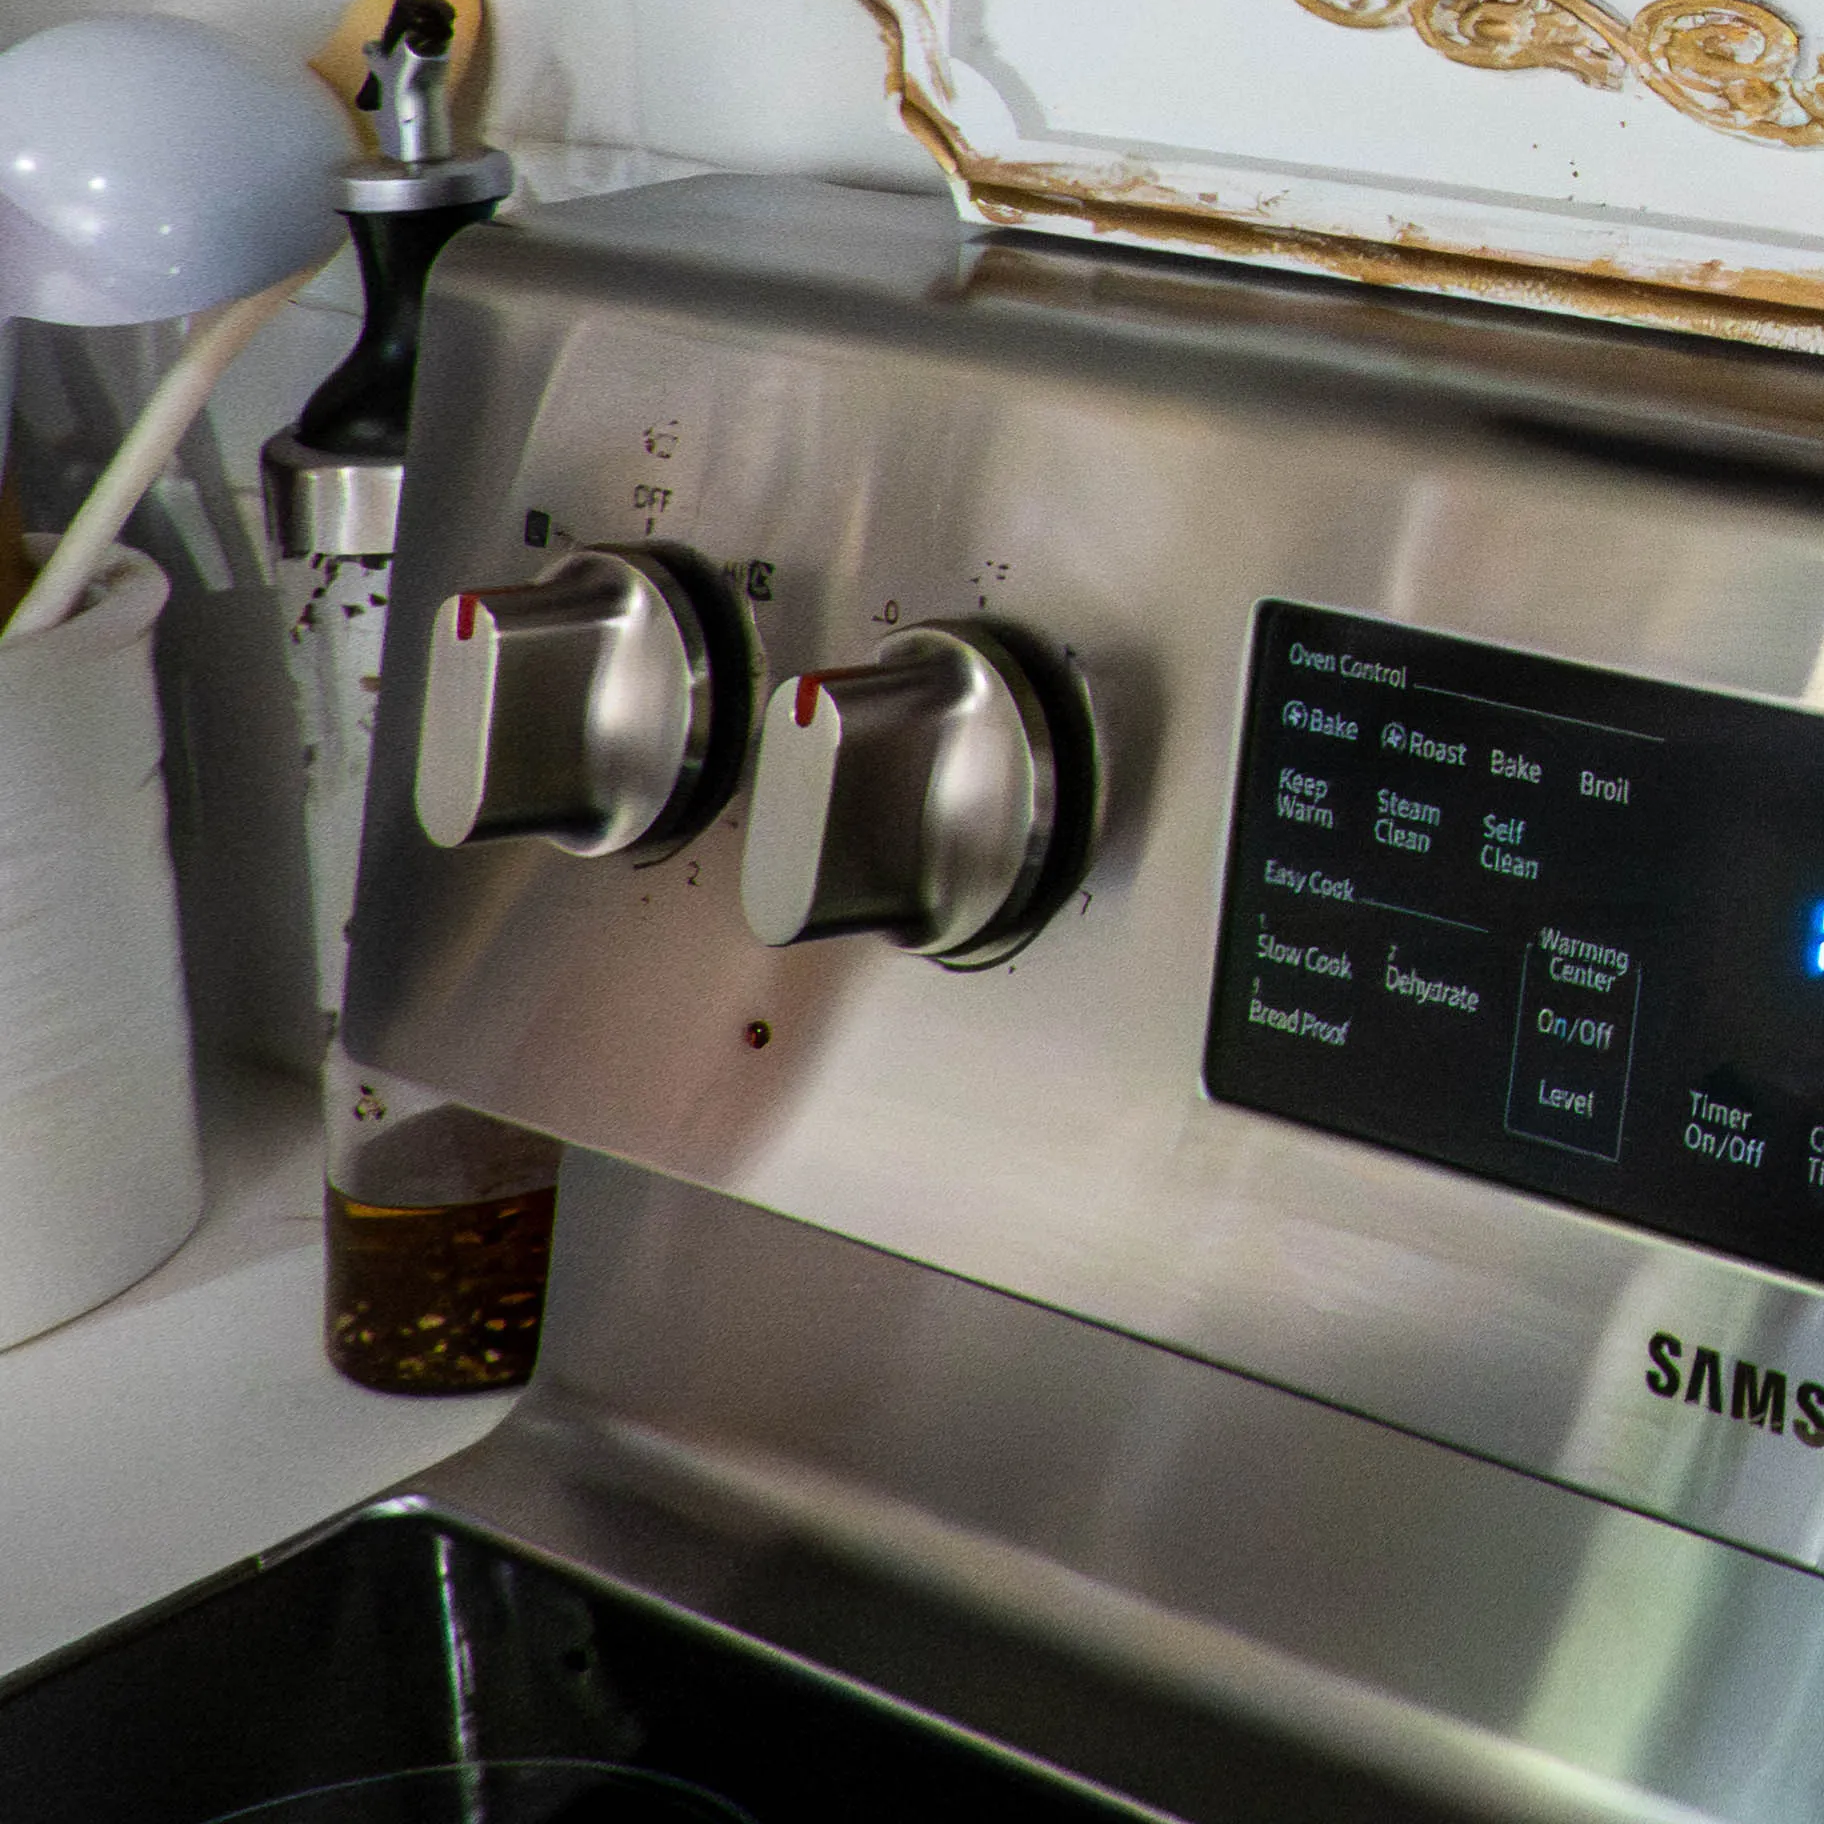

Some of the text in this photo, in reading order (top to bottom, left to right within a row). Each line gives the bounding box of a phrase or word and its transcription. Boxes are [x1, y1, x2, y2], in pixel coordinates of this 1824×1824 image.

[1289, 642, 1407, 690] Oven Control
[1309, 706, 1359, 742] Bake
[1409, 731, 1467, 767] Roast
[1490, 749, 1543, 784] Bake
[1279, 768, 1329, 805] Keep
[1579, 770, 1630, 806] Broil
[1277, 793, 1334, 830] Warm
[1377, 788, 1441, 827] Steam
[1374, 818, 1432, 854] Clean
[1482, 813, 1526, 846] Self
[1264, 859, 1354, 903] Easy Cook
[1480, 844, 1539, 880] Clean
[1257, 933, 1352, 980] Slow Cook
[1539, 927, 1630, 977] Warming
[1386, 964, 1480, 1013] Dehydrate
[1549, 956, 1617, 993] Center
[1537, 1007, 1615, 1050] On/Off
[1538, 1079, 1596, 1119] Level
[1689, 1089, 1753, 1132] Timer
[1683, 1123, 1766, 1169] On/Off
